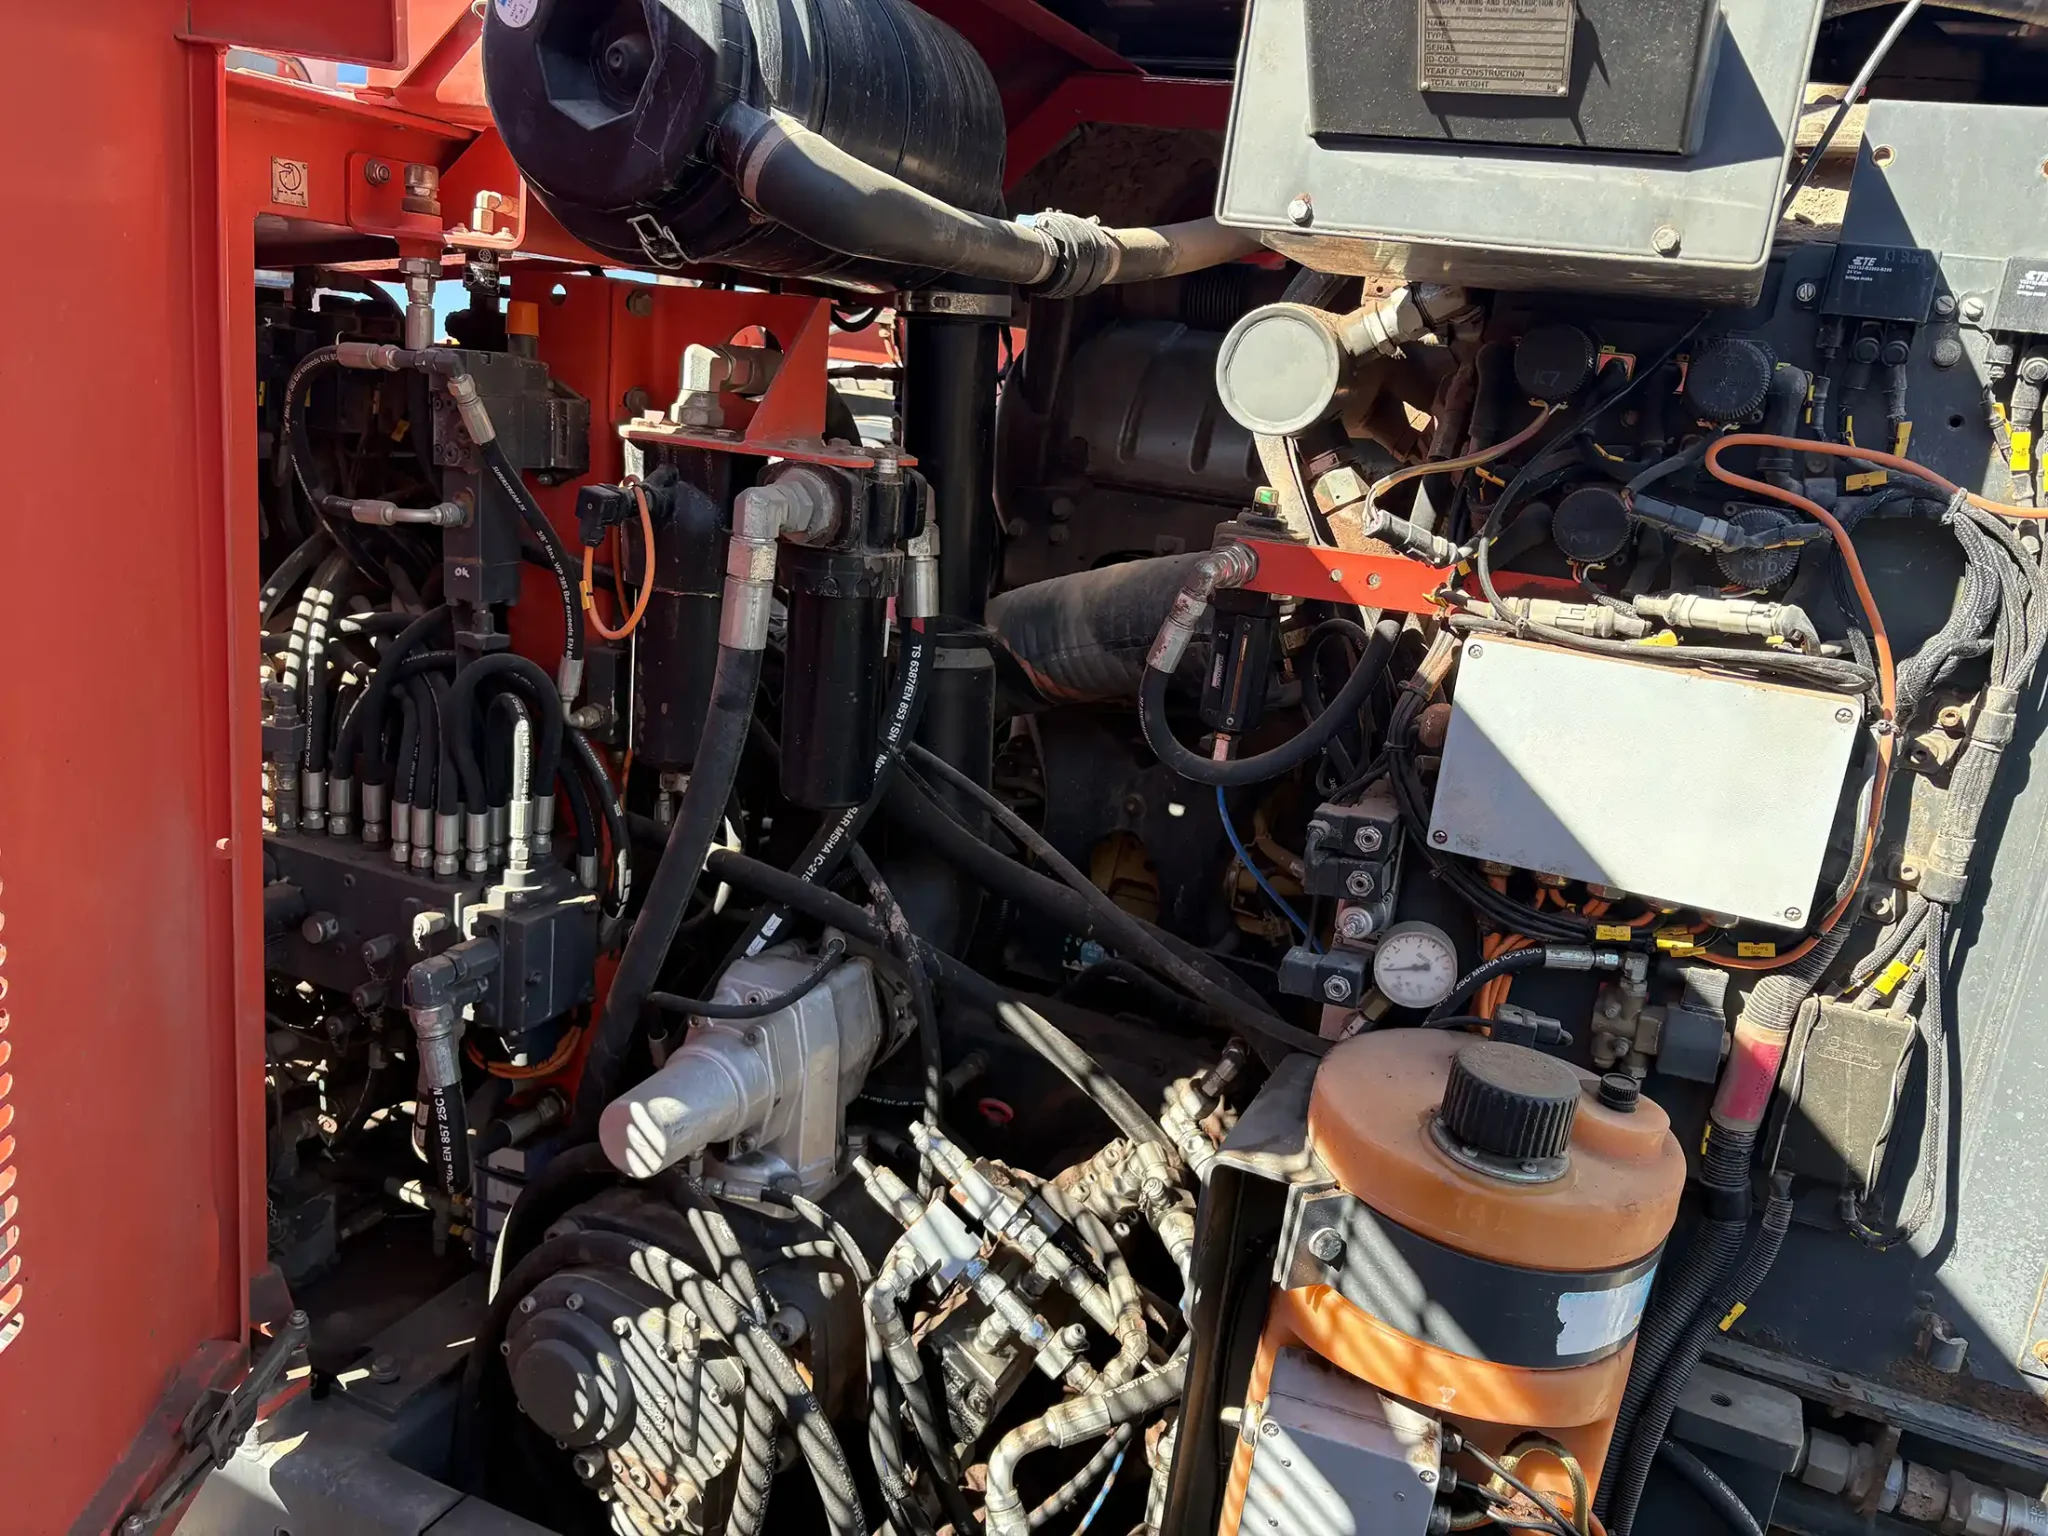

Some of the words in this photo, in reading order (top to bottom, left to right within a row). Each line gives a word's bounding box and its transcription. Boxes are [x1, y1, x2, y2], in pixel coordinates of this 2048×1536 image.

[1426, 44, 1455, 52] SERIAL
[1461, 68, 1524, 77] CONSTRUCTION
[1431, 79, 1453, 87] TOTAL
[1458, 80, 1489, 88] WEIGHT
[1547, 84, 1558, 92] kg
[492, 466, 521, 504] SUPERSTREAM
[554, 562, 564, 575] WP
[563, 590, 571, 603] Bar
[566, 605, 574, 636] exceeds
[566, 638, 574, 650] EN
[911, 645, 922, 659] TS
[902, 660, 920, 701] 6387/EN
[896, 702, 909, 720] 853
[887, 722, 902, 742] 1SN
[821, 826, 845, 853] MSHA
[801, 853, 826, 883] IC-215
[1471, 958, 1500, 977] MSHA
[1501, 948, 1542, 961] IC-215/0
[434, 1098, 448, 1121] 2SC
[439, 1124, 451, 1143] 857
[443, 1146, 452, 1161] EN
